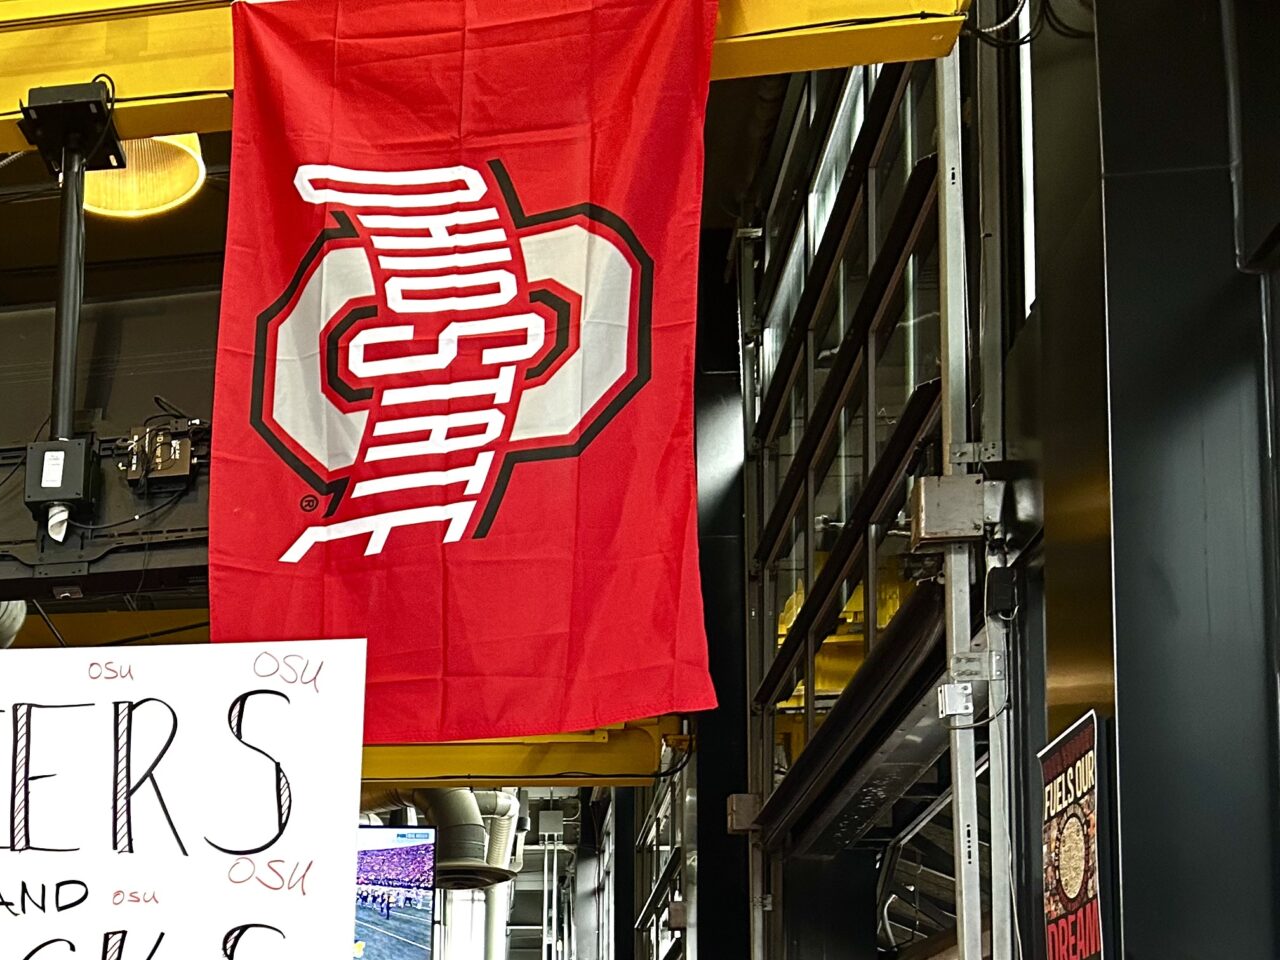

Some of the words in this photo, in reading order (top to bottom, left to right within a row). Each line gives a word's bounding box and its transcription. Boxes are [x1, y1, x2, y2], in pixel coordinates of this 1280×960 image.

[293, 163, 520, 314] OHIO
[277, 312, 546, 563] STATE
[89, 662, 134, 681] OSU
[253, 652, 324, 692] OSU
[1044, 766, 1074, 821] FUELS
[1075, 749, 1096, 800] OUR
[225, 855, 313, 896] OSU
[113, 889, 159, 906] OSU
